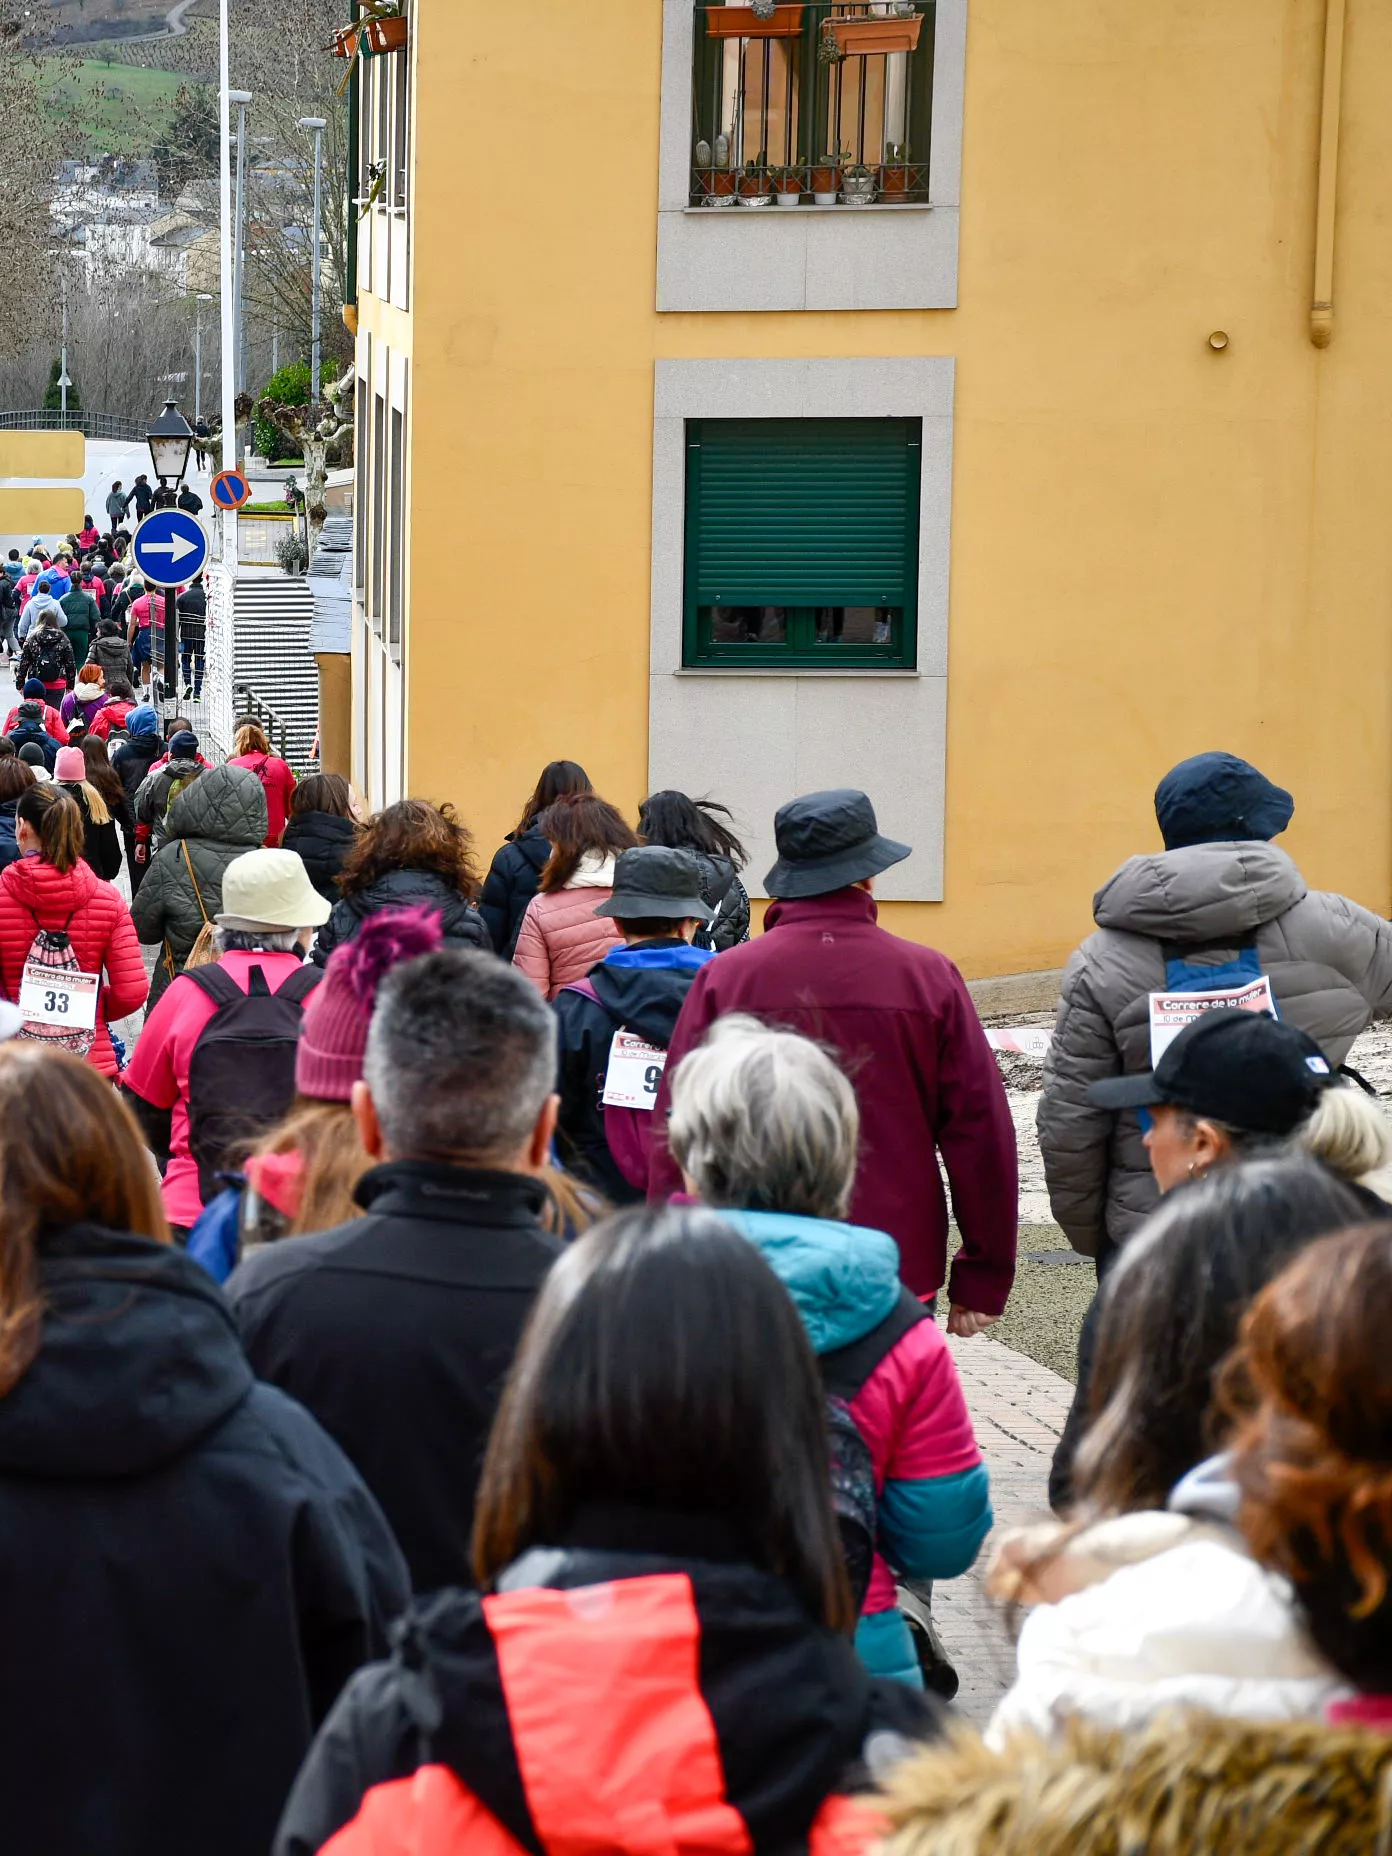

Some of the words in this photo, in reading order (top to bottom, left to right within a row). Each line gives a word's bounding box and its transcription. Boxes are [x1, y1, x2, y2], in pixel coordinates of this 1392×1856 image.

[30, 969, 56, 979] Carrera
[72, 977, 93, 985] mujer
[44, 990, 69, 1013] 33
[1163, 1000, 1209, 1009] Carrera
[1211, 999, 1225, 1008] de
[1227, 998, 1237, 1007] la
[1239, 988, 1262, 1004] mujer
